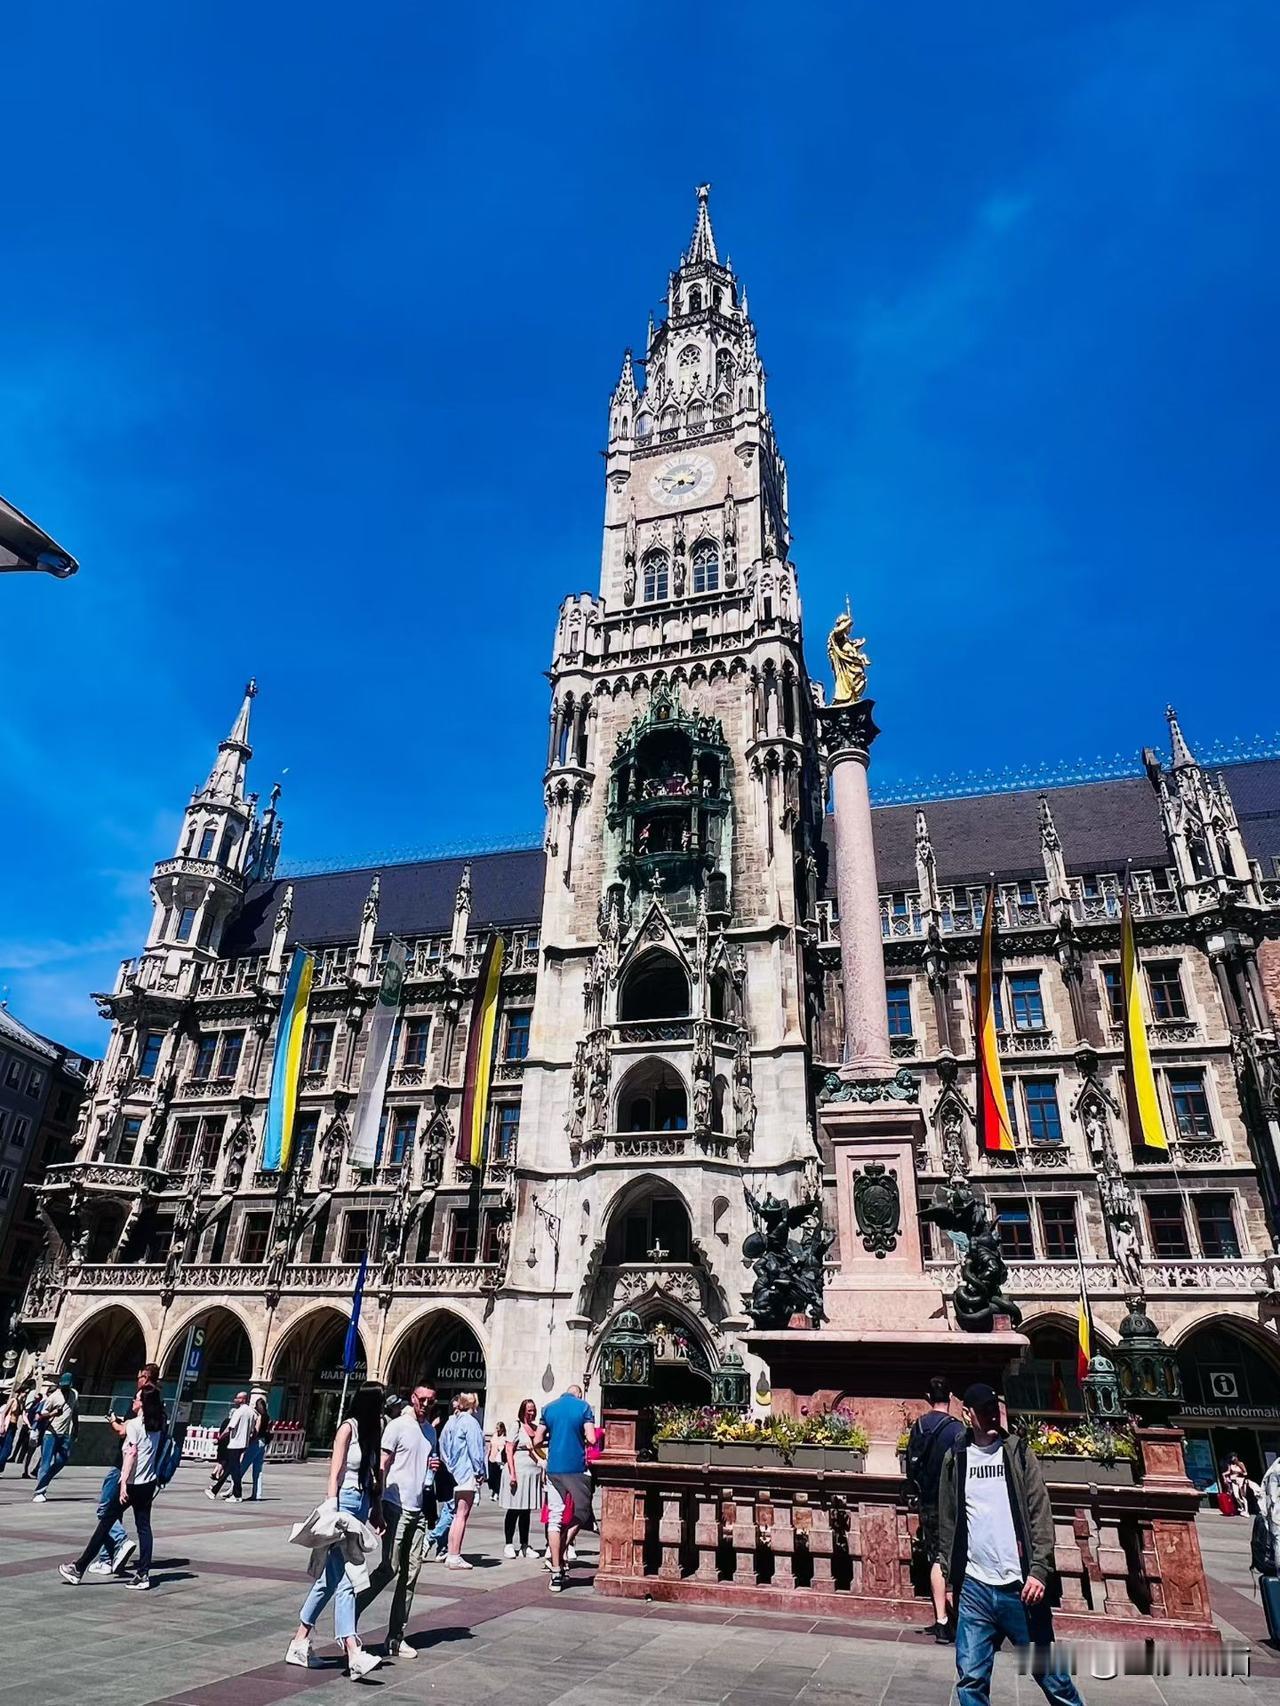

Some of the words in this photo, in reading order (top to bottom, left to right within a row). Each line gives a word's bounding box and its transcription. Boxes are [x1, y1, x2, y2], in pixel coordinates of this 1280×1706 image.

[194, 1329, 205, 1346] S
[190, 1351, 200, 1367] U
[437, 1367, 486, 1379] HORTKO
[1224, 1405, 1280, 1418] Informati
[969, 1464, 1004, 1479] PUMA
